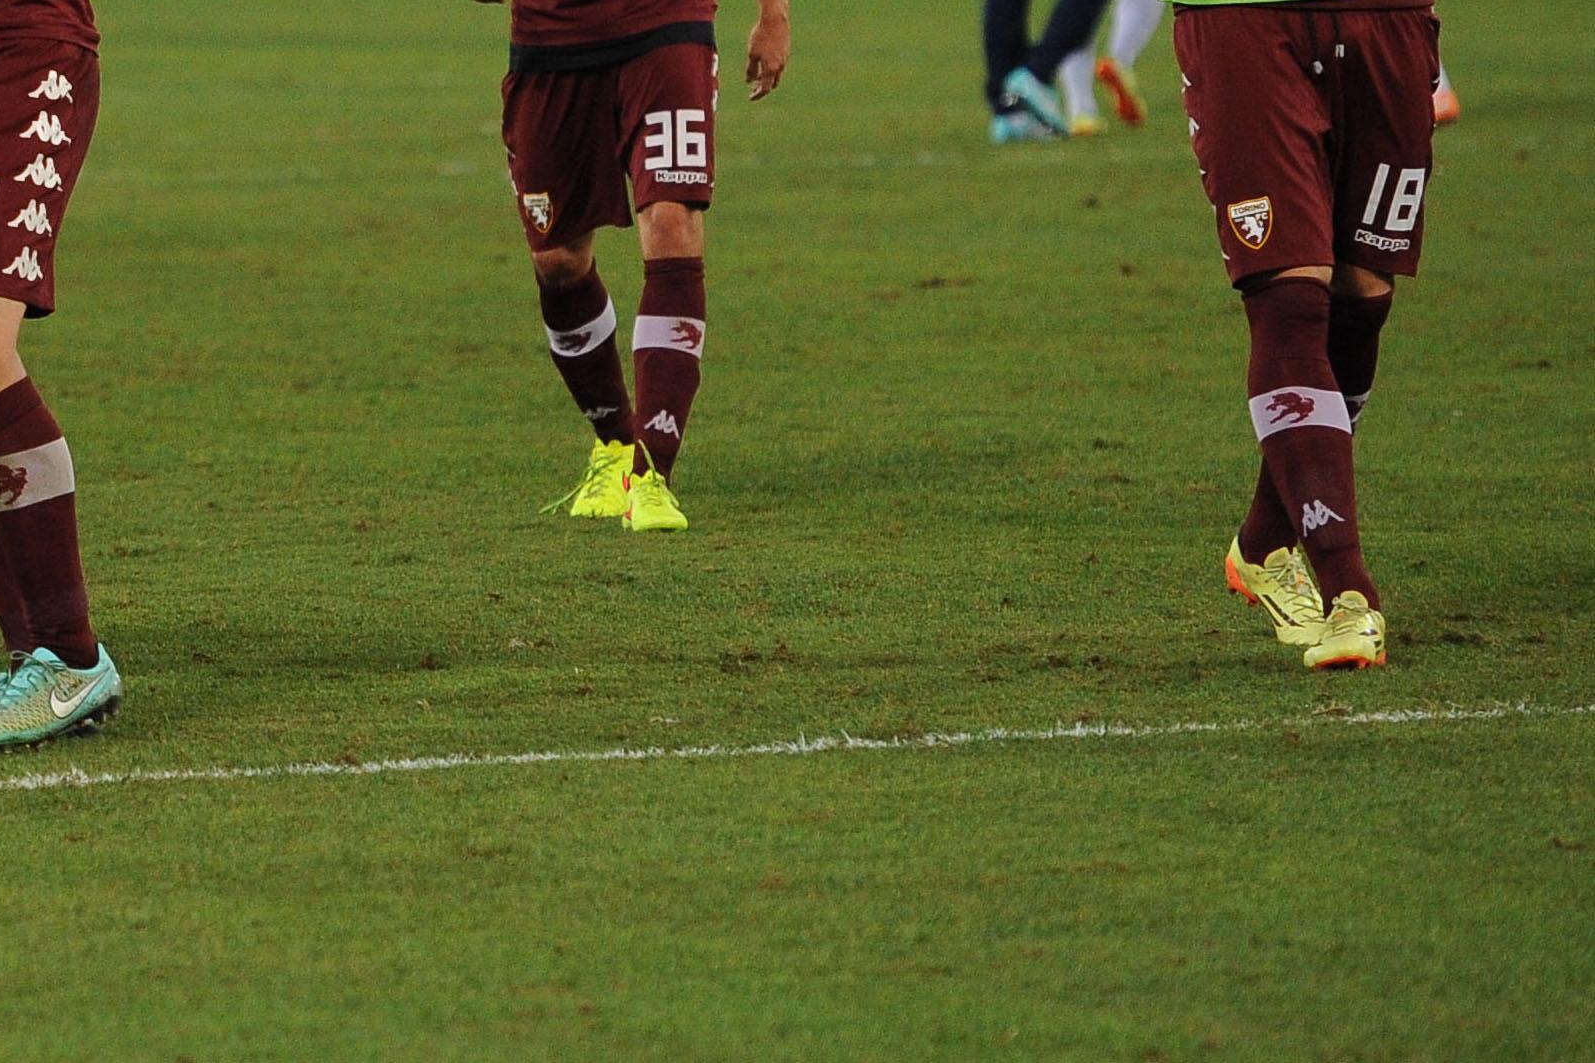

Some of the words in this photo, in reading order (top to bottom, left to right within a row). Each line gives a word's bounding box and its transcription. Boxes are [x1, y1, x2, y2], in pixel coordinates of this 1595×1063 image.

[644, 108, 707, 171] 36
[655, 169, 708, 184] Kappa
[1361, 162, 1426, 232] 18
